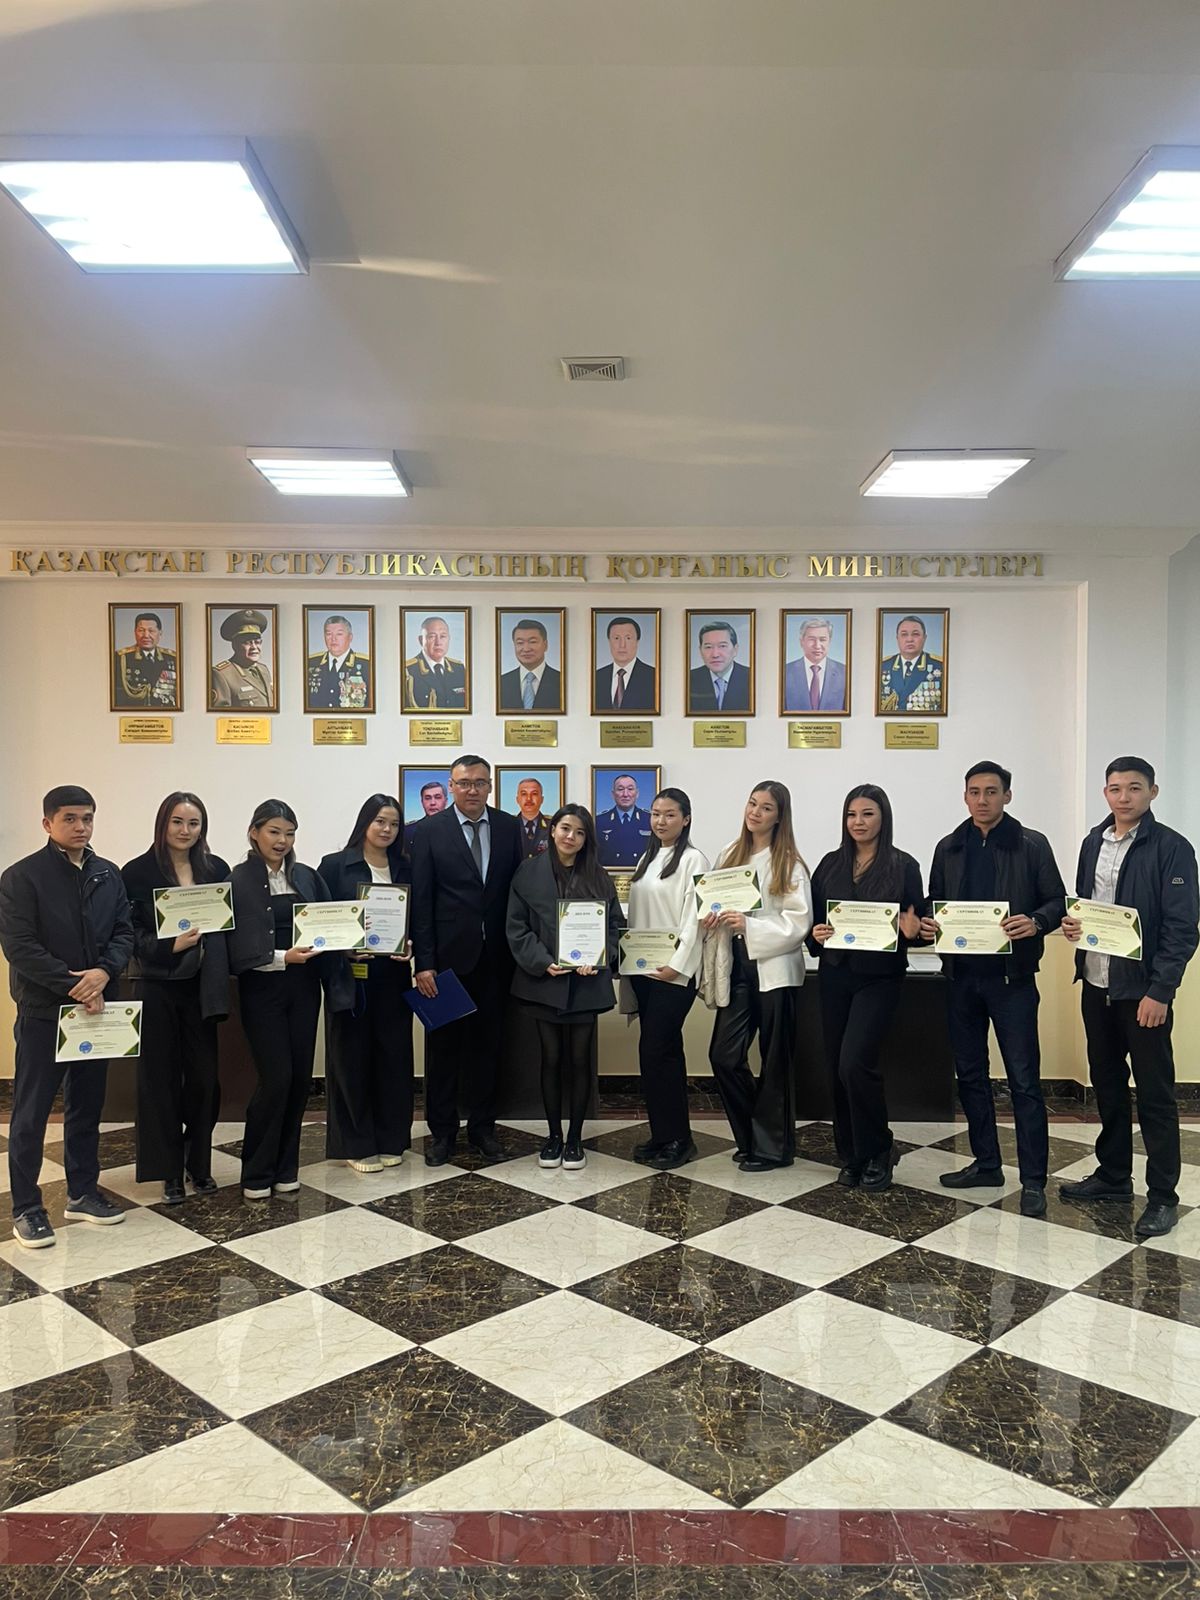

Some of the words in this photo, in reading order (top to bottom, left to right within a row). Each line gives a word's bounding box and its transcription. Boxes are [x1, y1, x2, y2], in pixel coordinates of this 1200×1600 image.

[10, 550, 205, 577] ҚАЗАҚСТАН
[226, 551, 588, 582] РЕСПУБЛИКАСЫНЫҢ
[606, 554, 790, 582] ҚОРҒАНЫС
[807, 554, 1044, 578] МИНИСТРЛЕРІ
